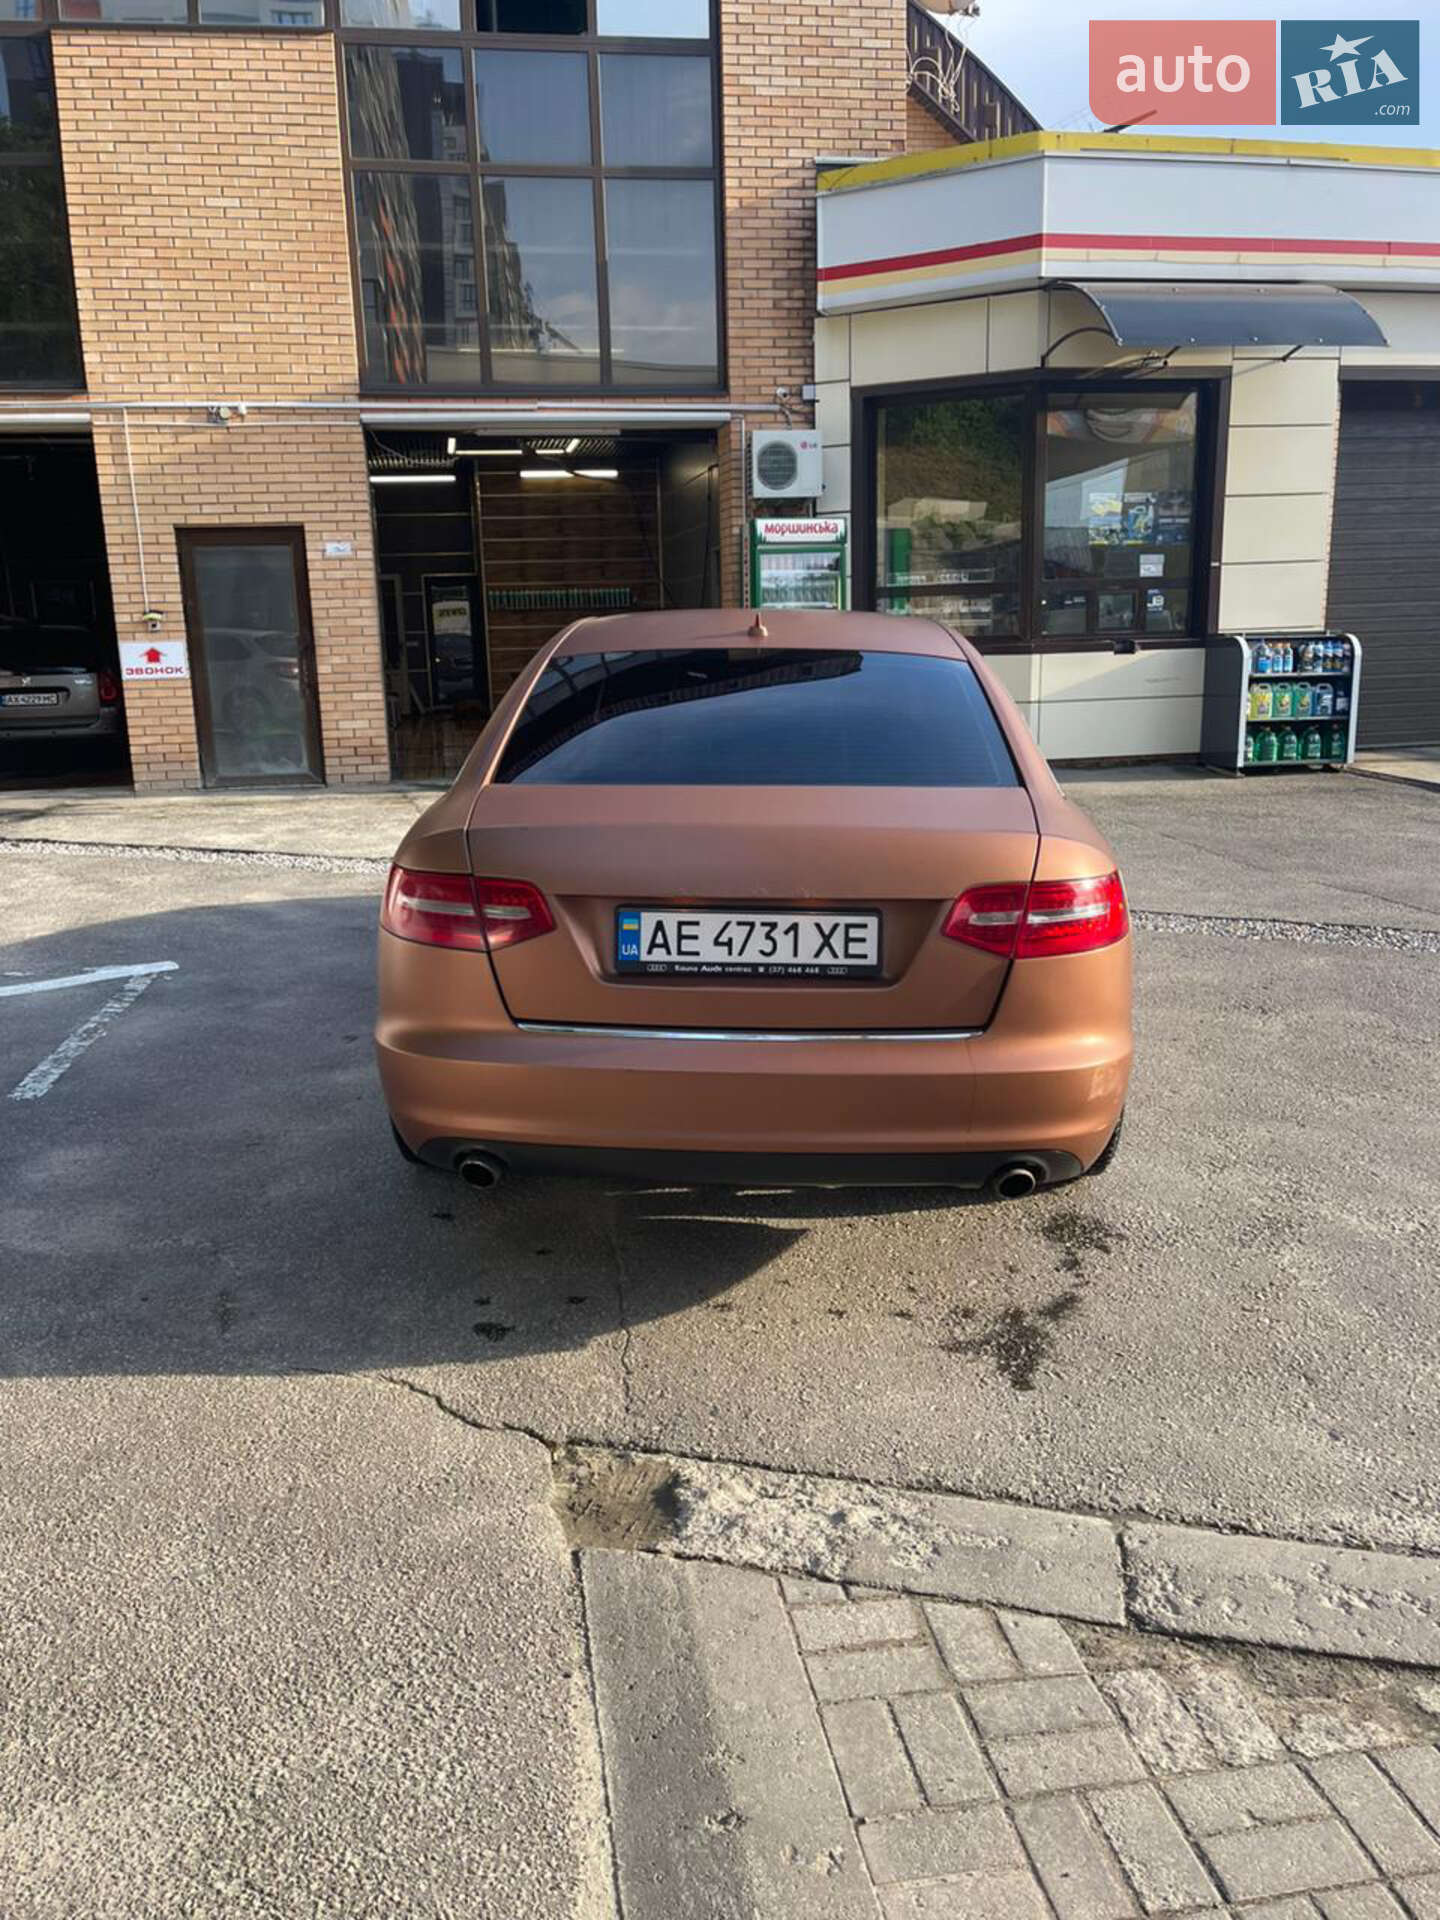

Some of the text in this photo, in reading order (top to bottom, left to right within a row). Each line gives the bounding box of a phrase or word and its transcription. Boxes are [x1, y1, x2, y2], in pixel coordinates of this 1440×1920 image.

[125, 666, 184, 676] ЗВОНОК
[646, 919, 869, 959] AE 4731 XE
[622, 944, 639, 955] UA
